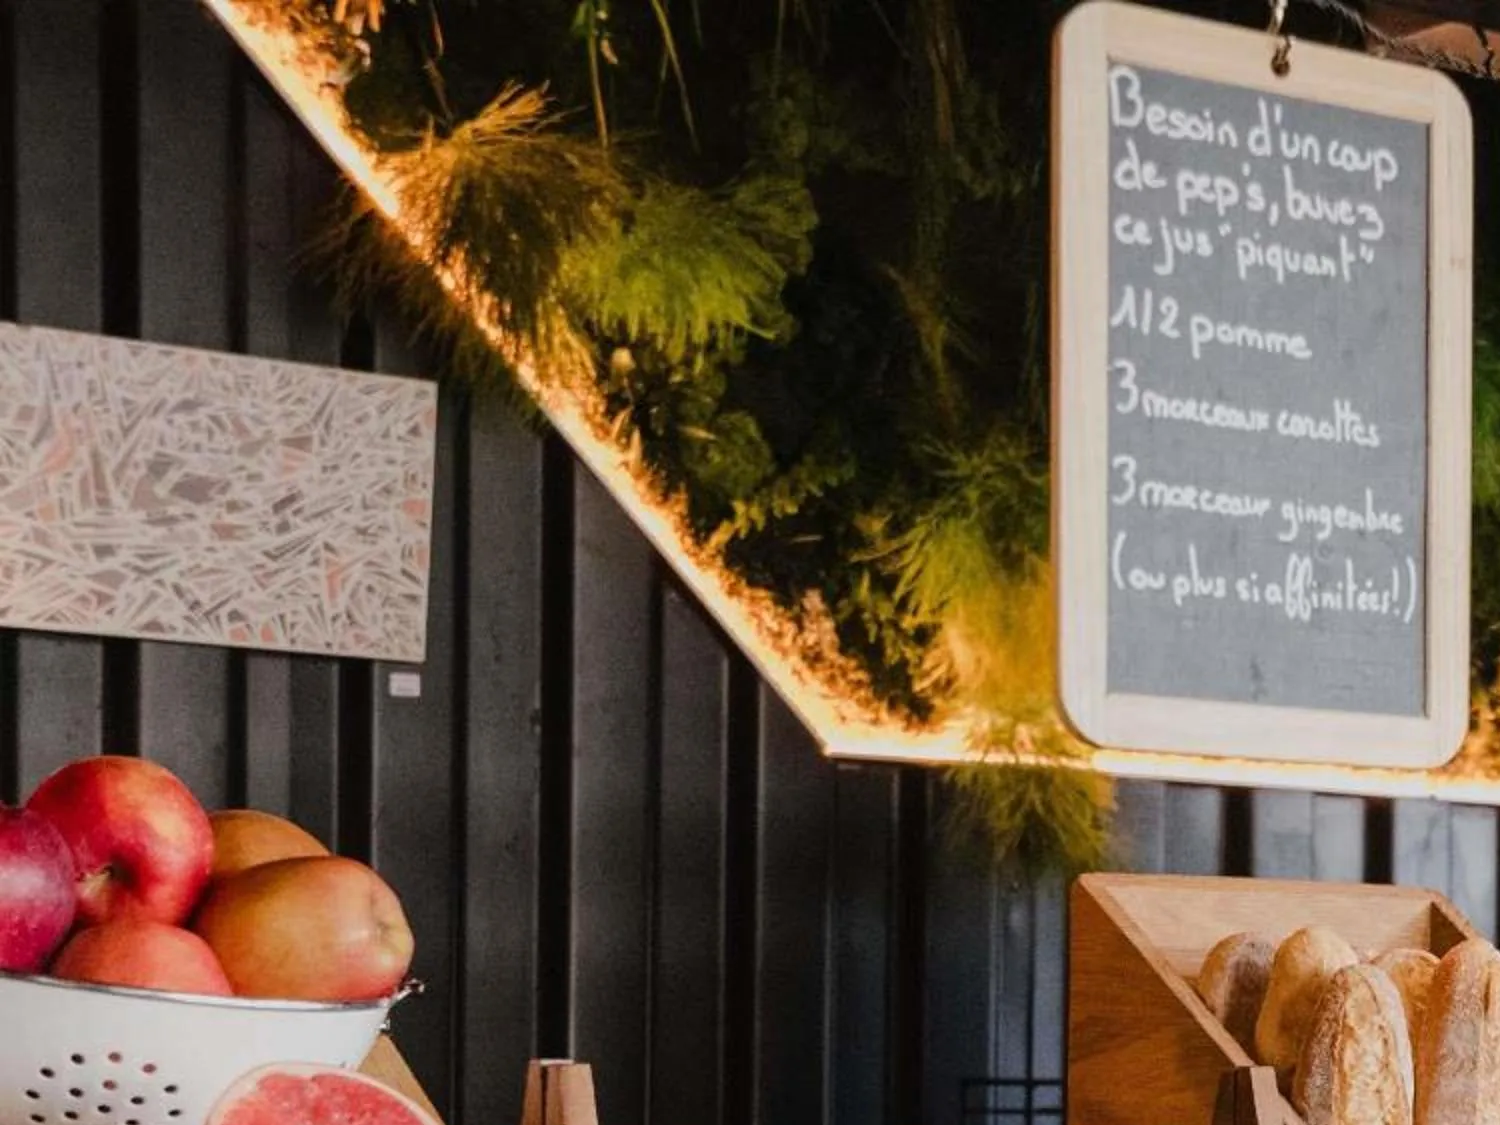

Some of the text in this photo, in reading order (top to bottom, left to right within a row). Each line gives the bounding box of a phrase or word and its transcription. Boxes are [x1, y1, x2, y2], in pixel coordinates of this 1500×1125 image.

[1110, 67, 1399, 190] Besoin d'un coup
[1113, 139, 1167, 191] de
[1114, 213, 1153, 247] ce
[1153, 217, 1214, 276] jus
[1189, 313, 1312, 359] pomme
[1113, 359, 1139, 414] 3
[1112, 455, 1137, 506] 3
[1173, 543, 1227, 606] plus
